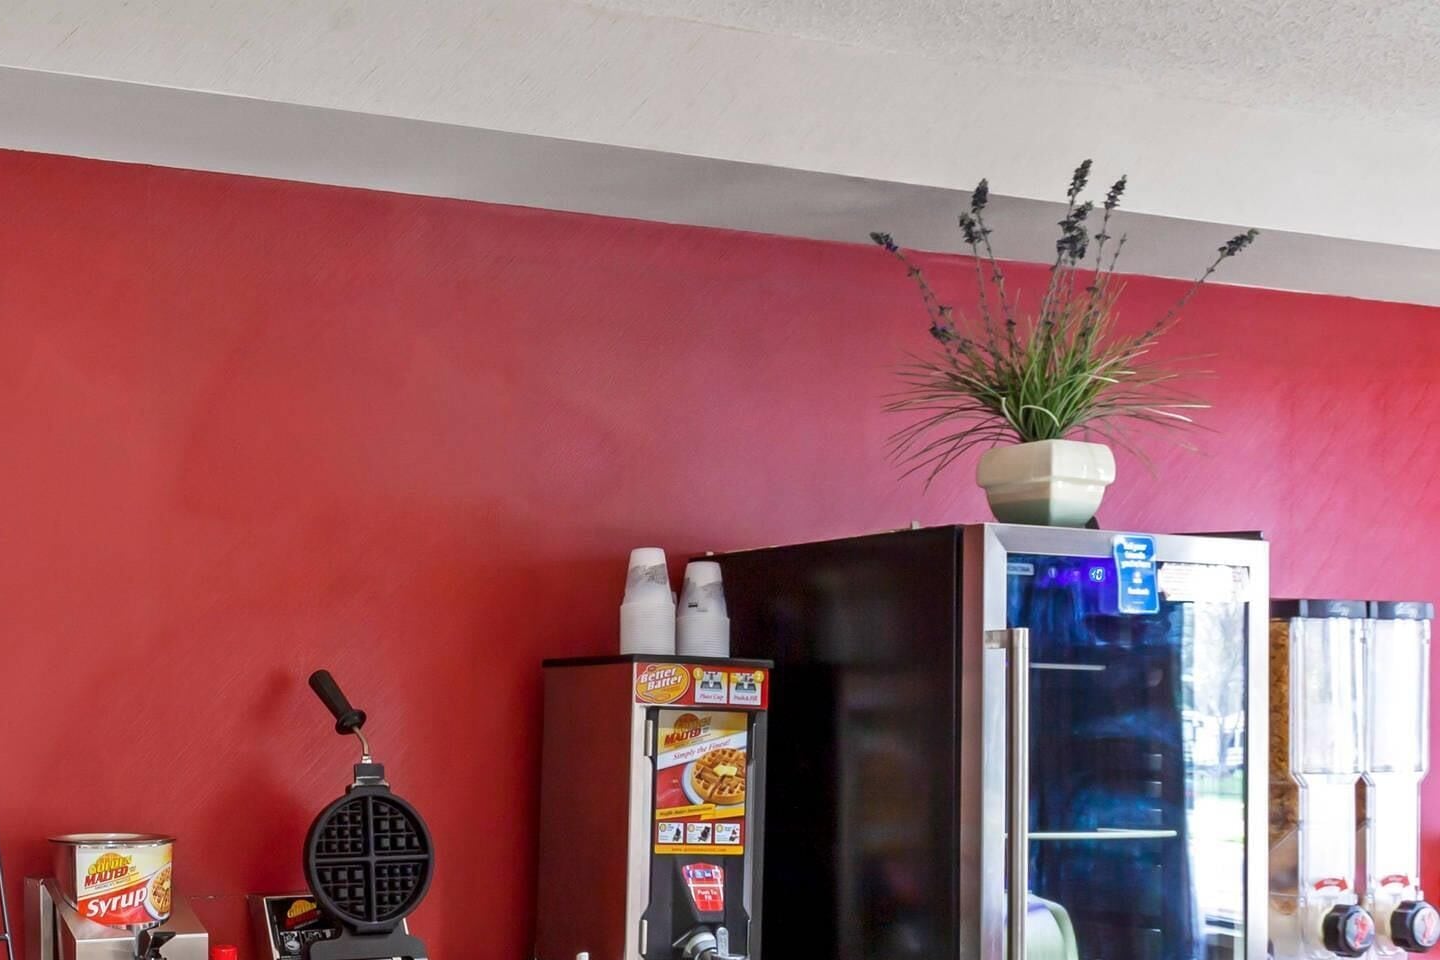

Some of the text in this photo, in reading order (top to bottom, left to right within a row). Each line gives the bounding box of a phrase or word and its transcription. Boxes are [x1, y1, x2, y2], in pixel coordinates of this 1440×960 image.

[640, 667, 677, 684] Better
[647, 675, 683, 691] Batter
[664, 727, 702, 746] MALTED
[84, 866, 130, 887] MALTED
[85, 887, 148, 918] Syrup
